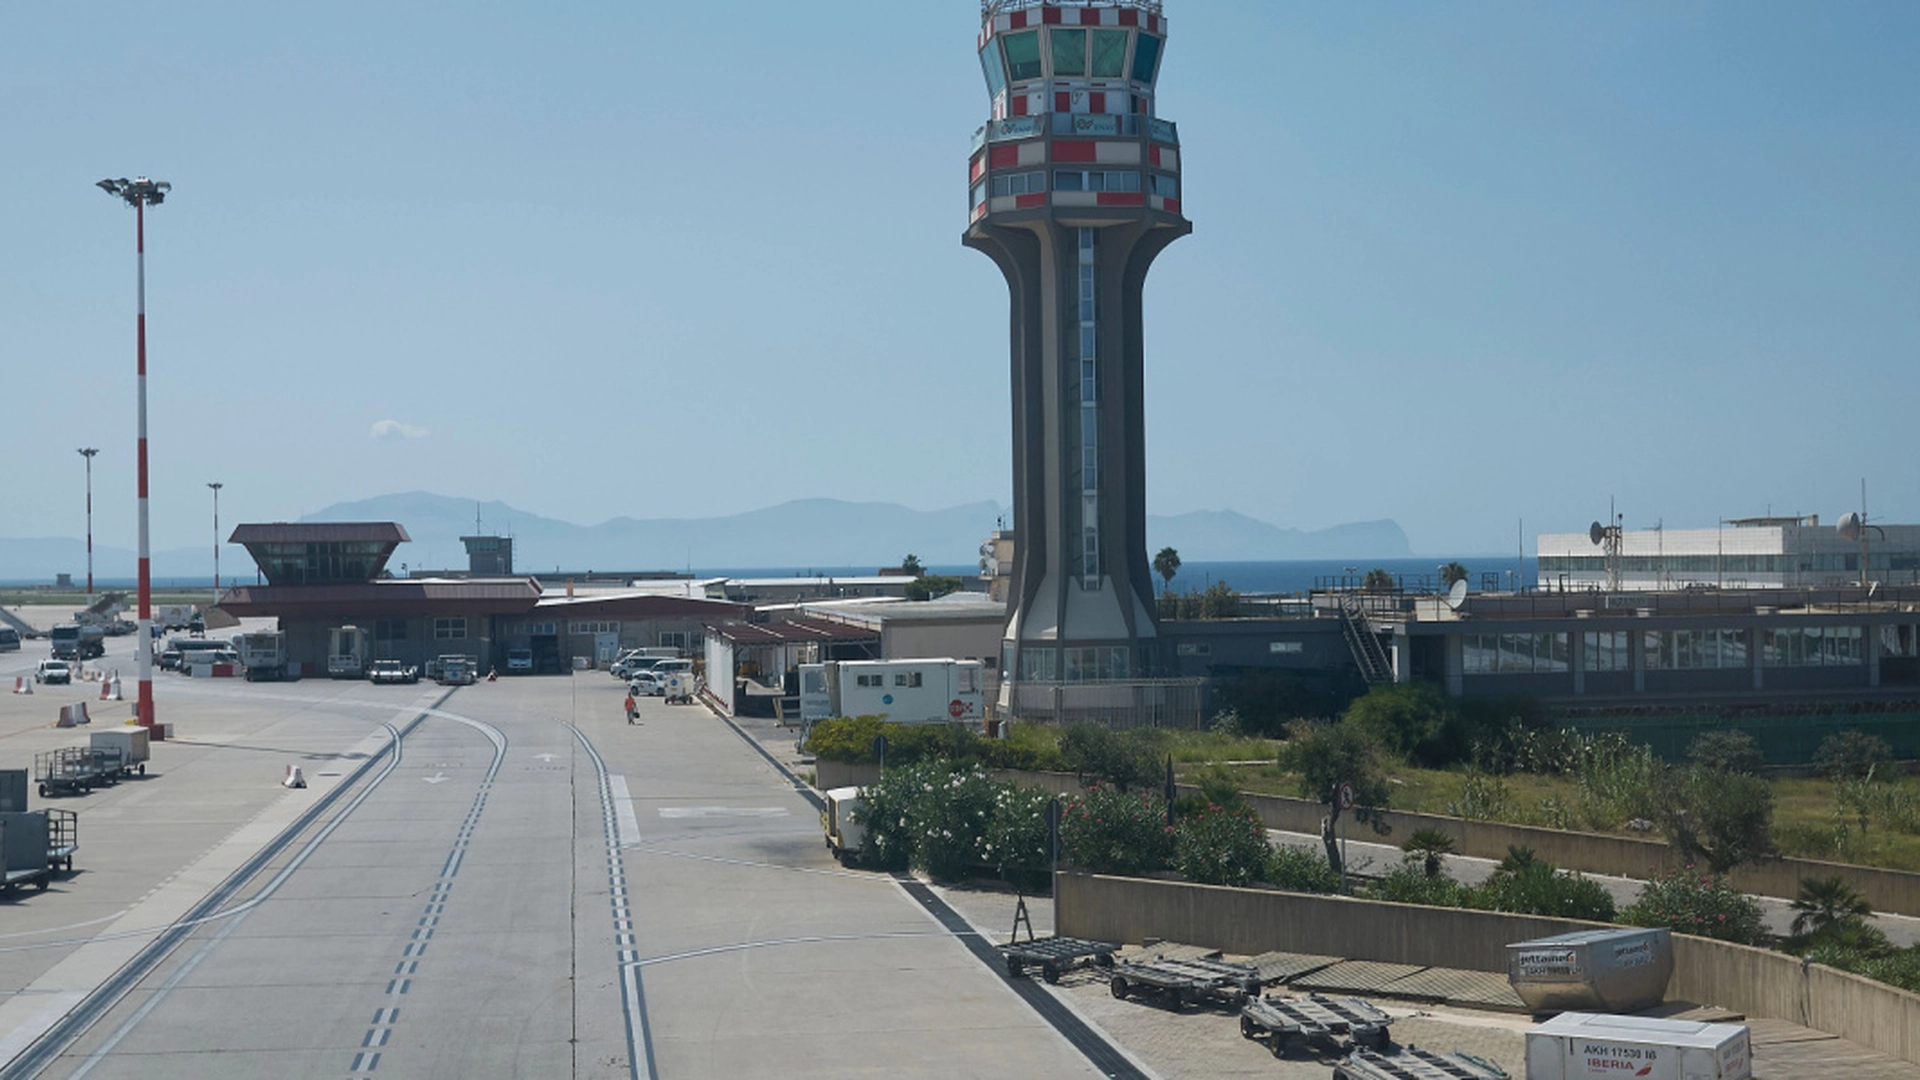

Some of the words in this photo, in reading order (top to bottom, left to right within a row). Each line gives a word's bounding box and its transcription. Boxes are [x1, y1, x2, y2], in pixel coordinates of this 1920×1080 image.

[1521, 952, 1573, 964] jettainer
[1584, 1045, 1608, 1055] AKH
[1611, 1047, 1641, 1059] 17530
[1587, 1058, 1634, 1069] IBERIA
